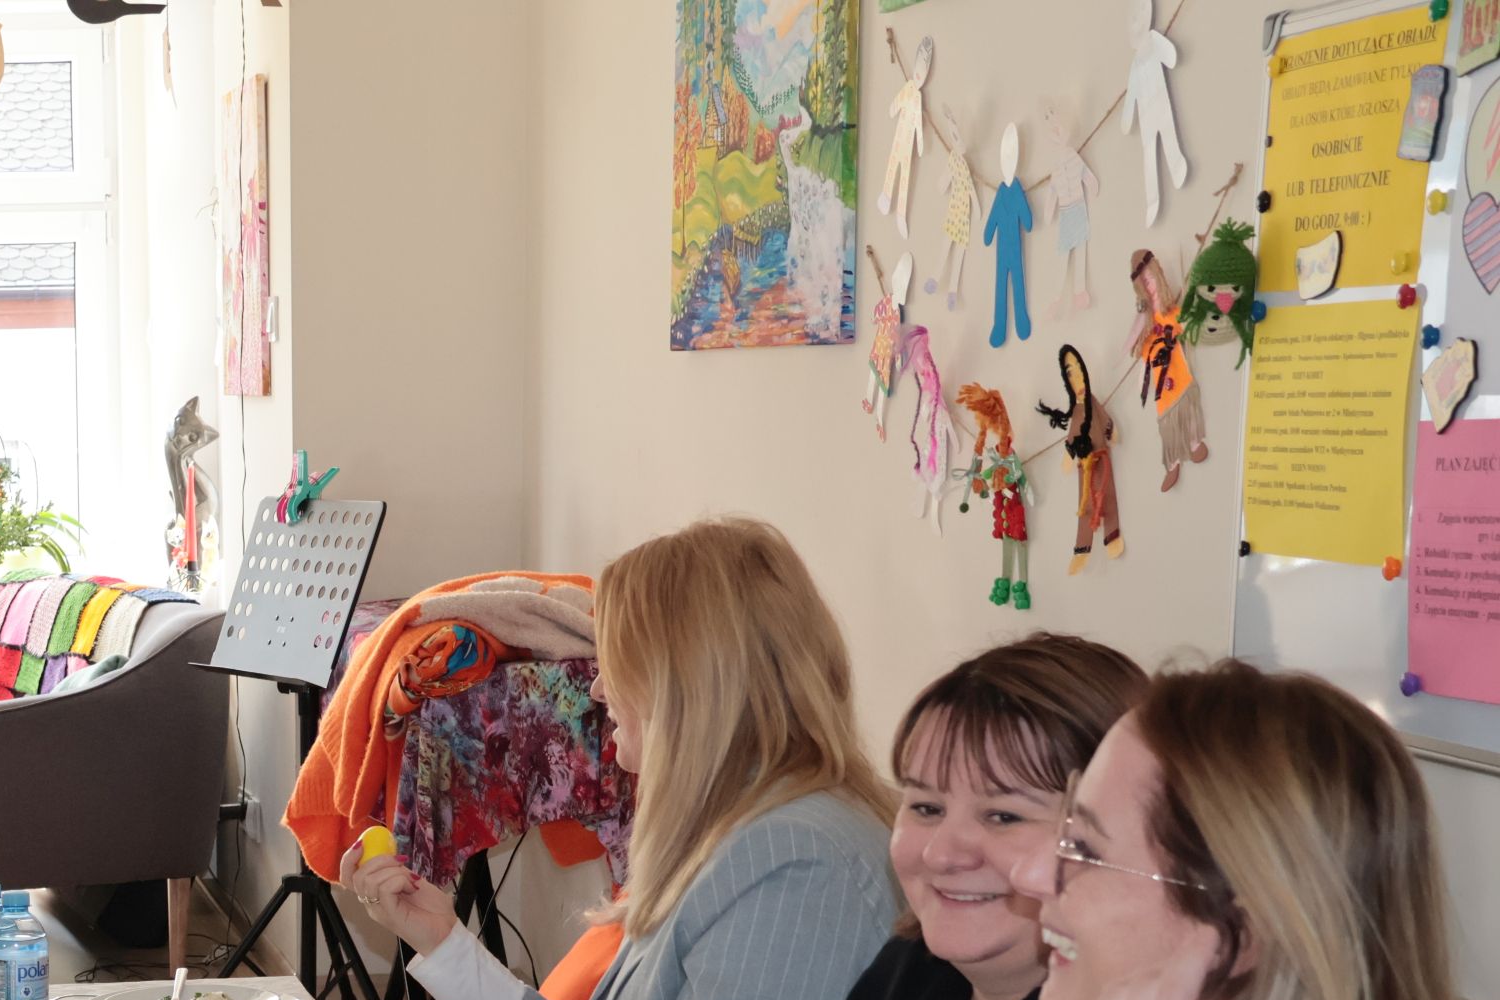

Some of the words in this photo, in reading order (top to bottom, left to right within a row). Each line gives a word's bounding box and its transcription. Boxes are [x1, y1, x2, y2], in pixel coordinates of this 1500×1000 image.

[1312, 135, 1364, 158] OSOBIŚCIE
[1286, 180, 1304, 197] LUB
[1310, 169, 1391, 195] TELEFONICZNIE
[1294, 216, 1310, 232] DO
[1435, 456, 1461, 472] PLAN
